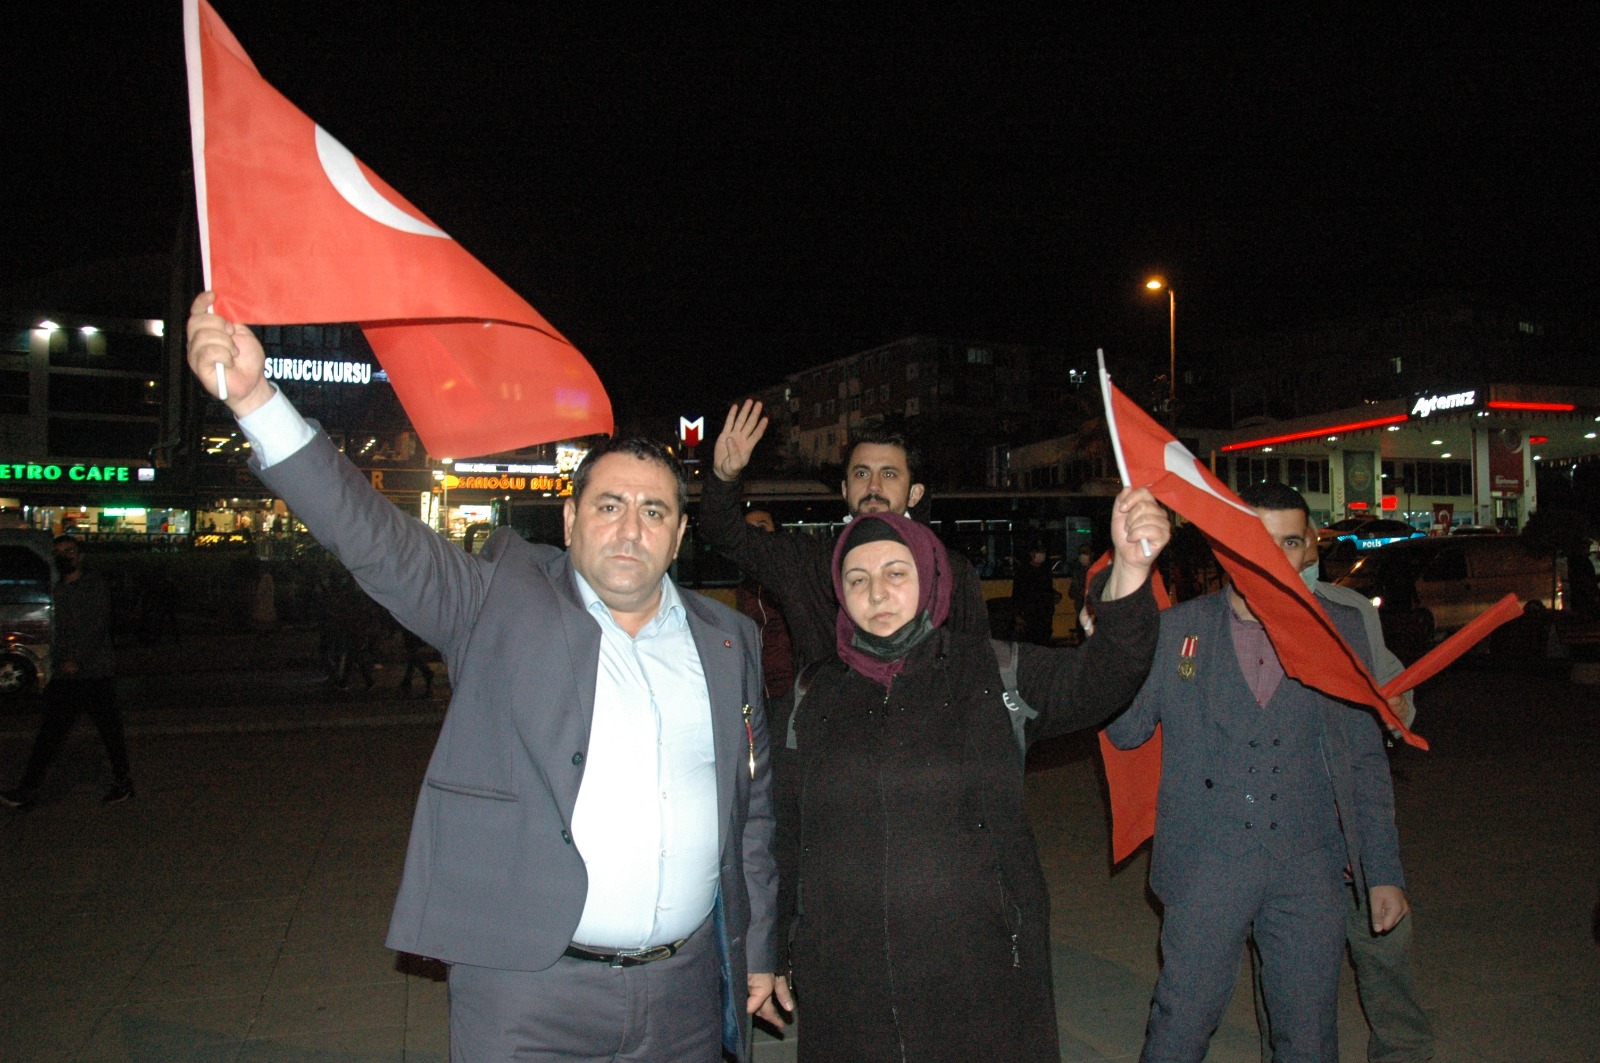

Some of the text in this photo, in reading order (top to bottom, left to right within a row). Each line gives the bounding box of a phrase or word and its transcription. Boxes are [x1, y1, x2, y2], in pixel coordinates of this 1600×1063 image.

[263, 356, 371, 385] SÜRÜCÜ KURSU
[1411, 390, 1475, 418] Aytemiz
[680, 416, 704, 441] M
[68, 465, 130, 481] CAFE
[458, 473, 526, 490] SARIOĞLU
[1362, 539, 1382, 548] POLİS
